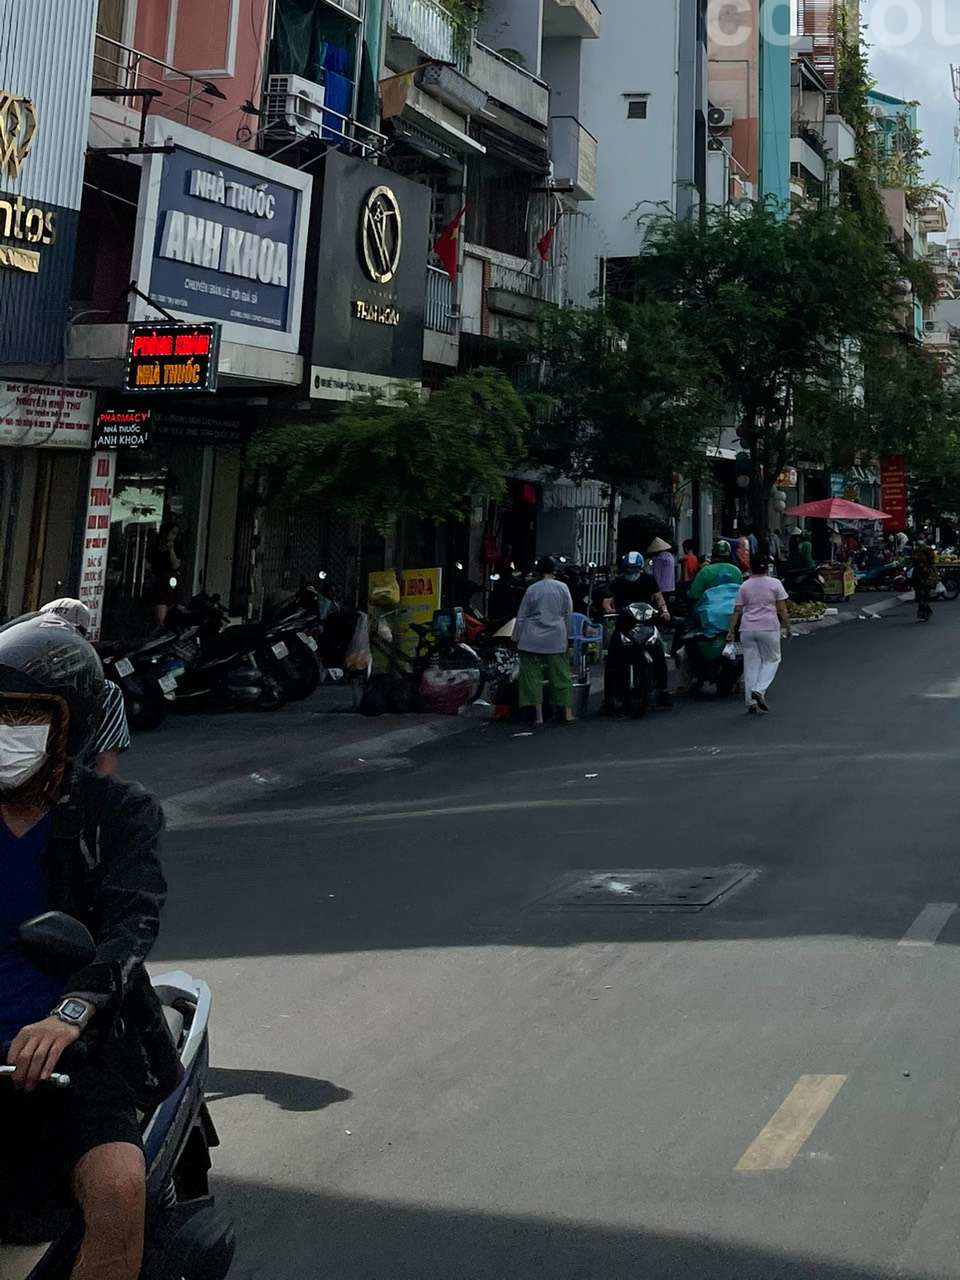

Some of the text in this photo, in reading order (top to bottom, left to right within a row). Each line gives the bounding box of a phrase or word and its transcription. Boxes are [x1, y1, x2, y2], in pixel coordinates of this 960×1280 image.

[189, 169, 276, 220] NHÀ THUỐC
[160, 210, 288, 288] ANH KHOA
[100, 412, 148, 423] PHARMACY
[97, 435, 117, 445] ANH
[119, 434, 145, 445] KHOA
